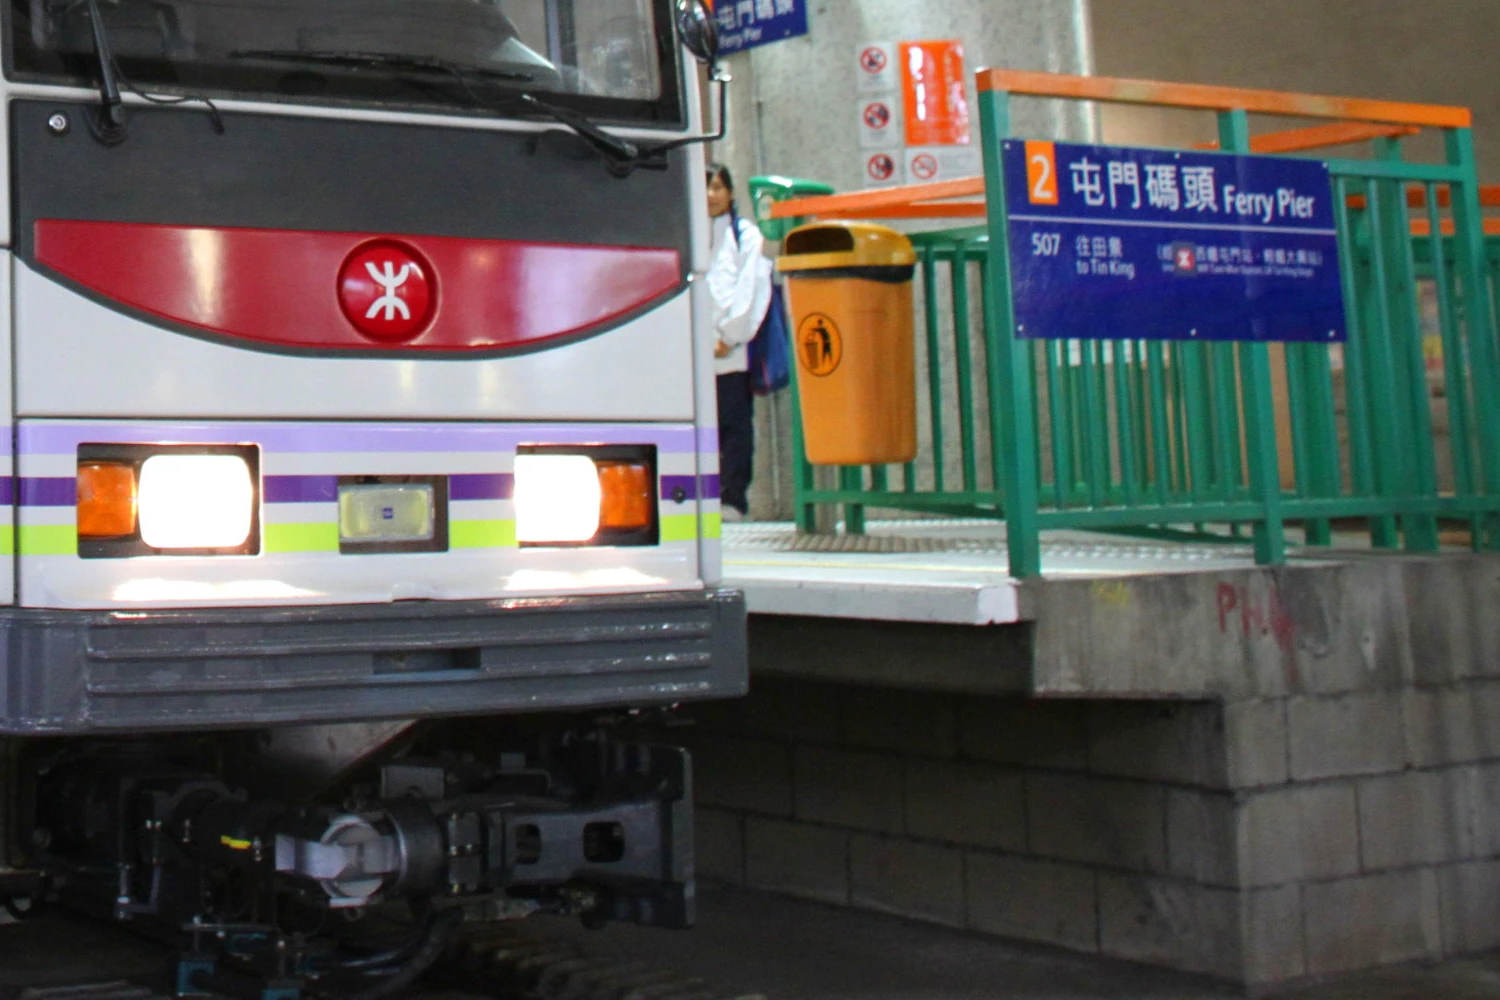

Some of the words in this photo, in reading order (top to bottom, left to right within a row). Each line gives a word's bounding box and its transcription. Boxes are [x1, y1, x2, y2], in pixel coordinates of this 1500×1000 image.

[1031, 154, 1053, 199] 2
[1070, 157, 1219, 213] 屯門碼頭
[1223, 185, 1274, 223] Ferry
[1278, 189, 1315, 219] Pier
[1031, 233, 1061, 256] 507
[1076, 260, 1089, 275] to
[1090, 258, 1108, 275] Tin
[1109, 260, 1136, 280] King
